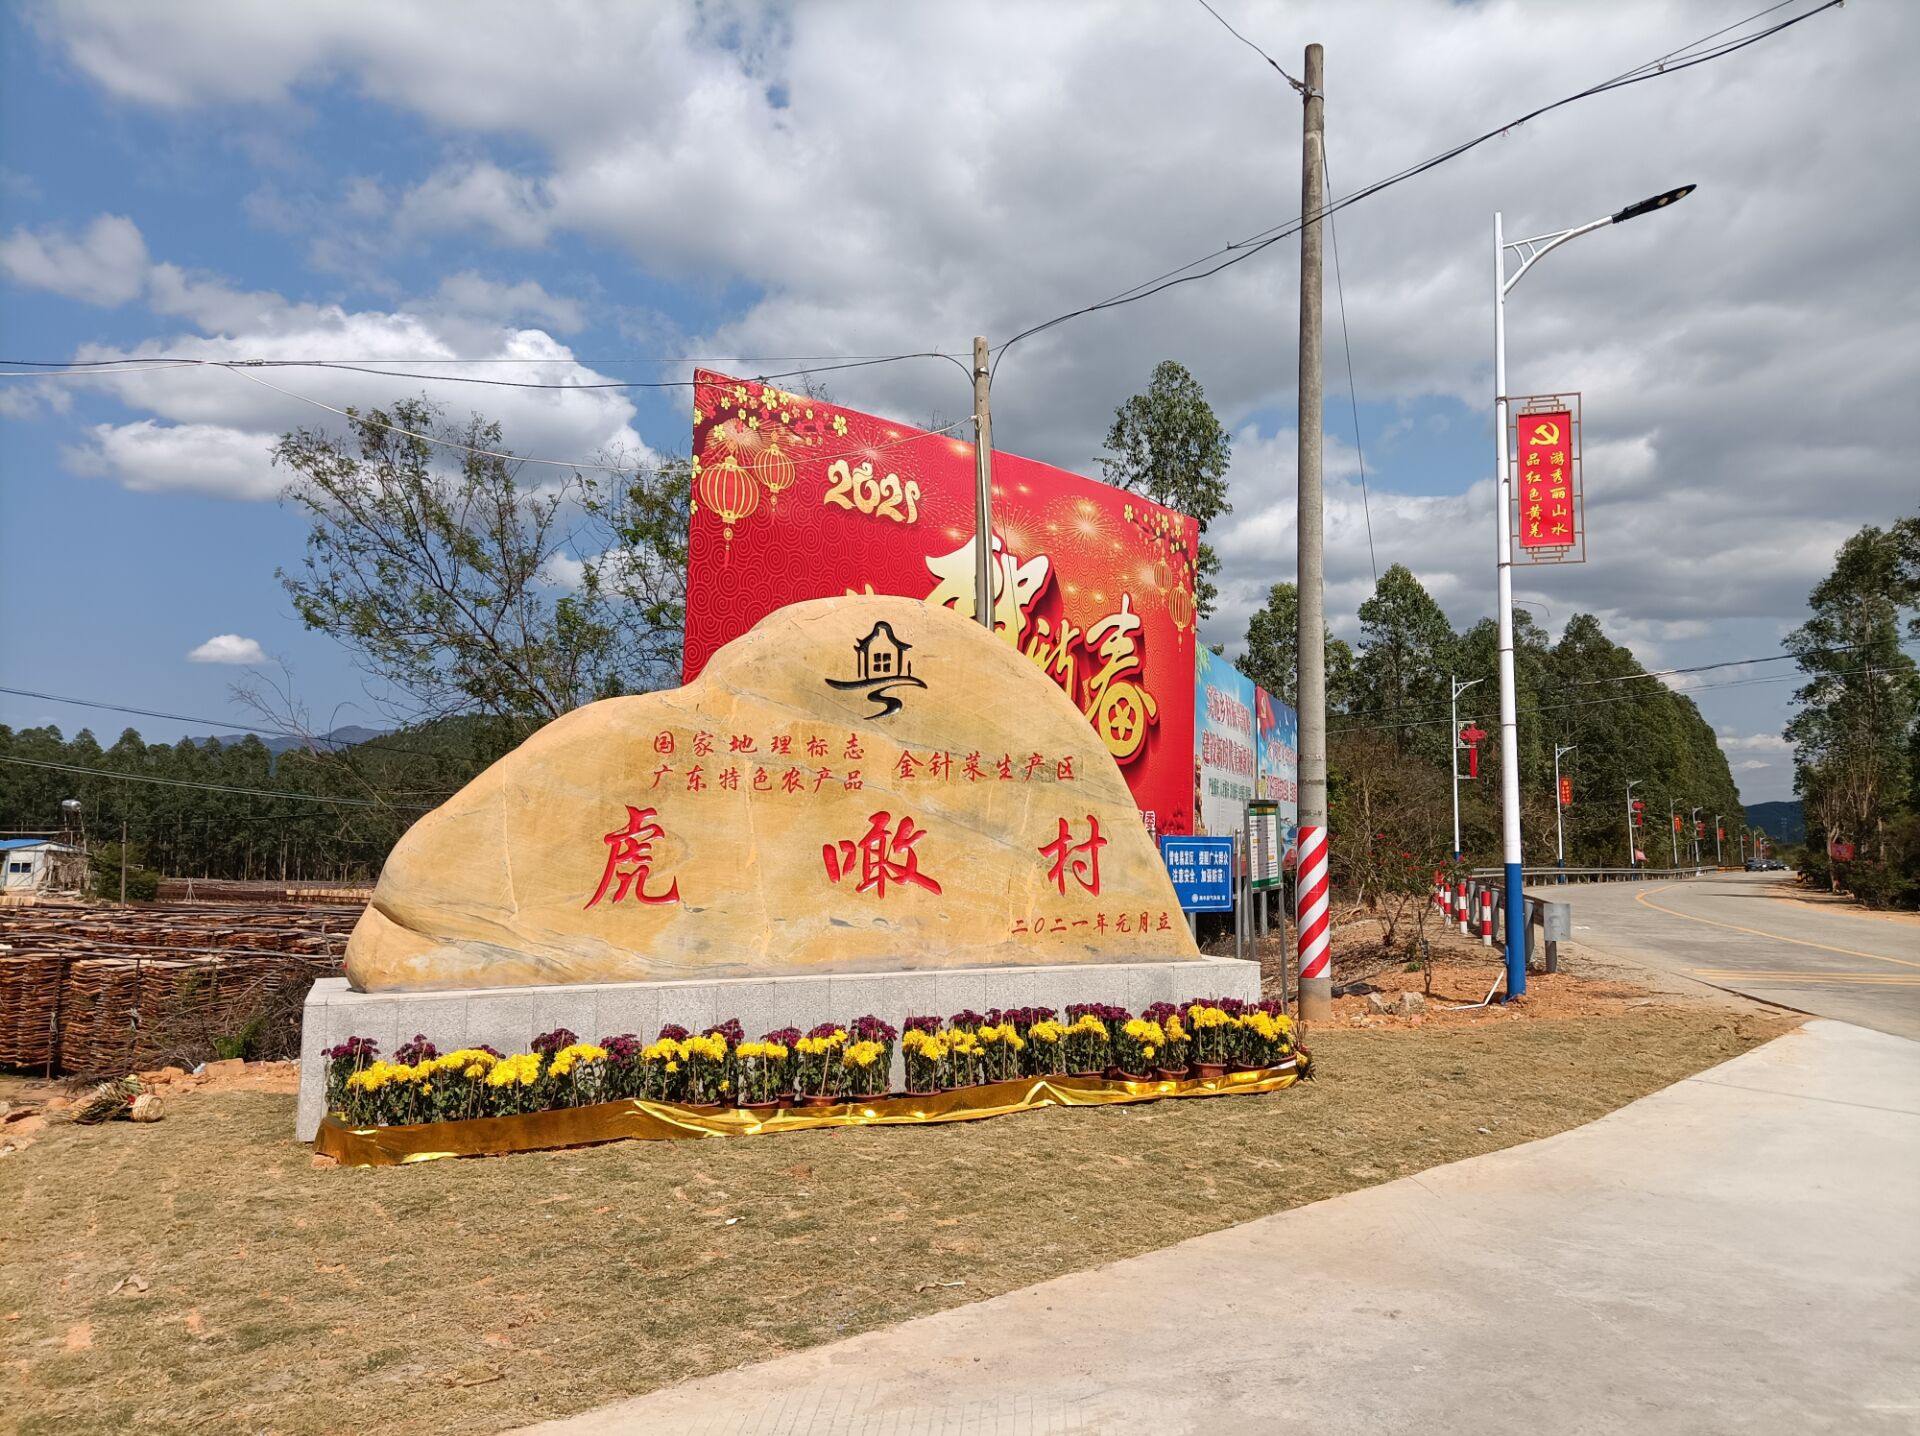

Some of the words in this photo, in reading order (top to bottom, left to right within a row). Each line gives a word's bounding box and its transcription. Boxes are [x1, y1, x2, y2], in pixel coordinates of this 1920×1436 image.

[824, 459, 921, 524] 2021
[1550, 451, 1568, 536] 游秀丽山水
[652, 731, 866, 761] 国家地理标志
[649, 764, 865, 795] 广东特色农产品
[893, 748, 1076, 784] 金针菜生产区
